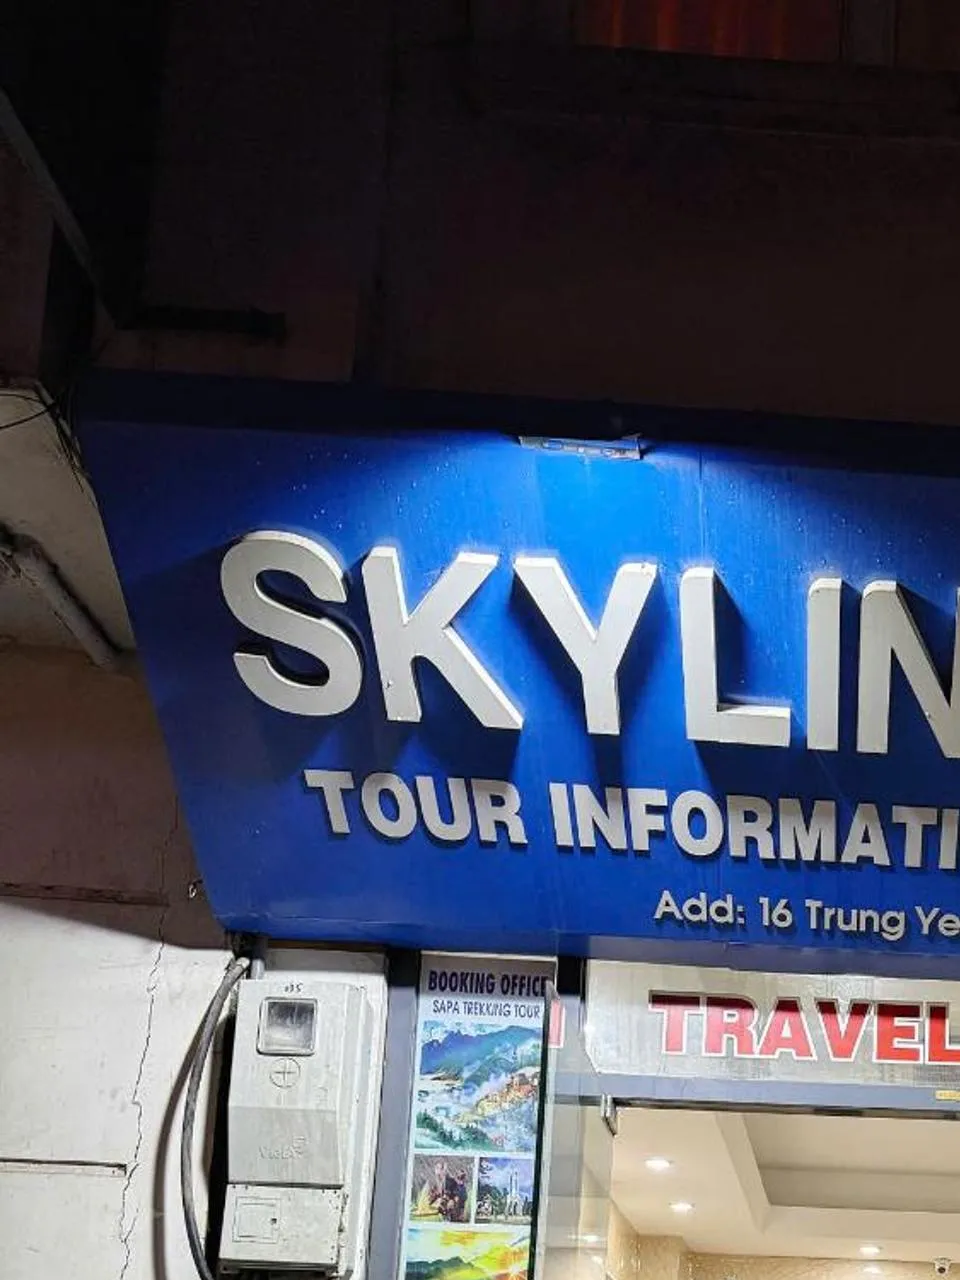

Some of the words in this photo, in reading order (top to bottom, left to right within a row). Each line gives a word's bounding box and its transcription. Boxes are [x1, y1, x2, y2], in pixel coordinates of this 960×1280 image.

[304, 769, 527, 846] TOUR
[654, 890, 745, 924] Add:
[758, 896, 793, 928] 16
[805, 899, 905, 941] Trung
[428, 969, 496, 994] BOOKING
[501, 973, 549, 997] OFFICE
[433, 1000, 460, 1014] SAPA
[463, 1001, 511, 1017] TREKKING
[514, 1004, 540, 1018] TOUR
